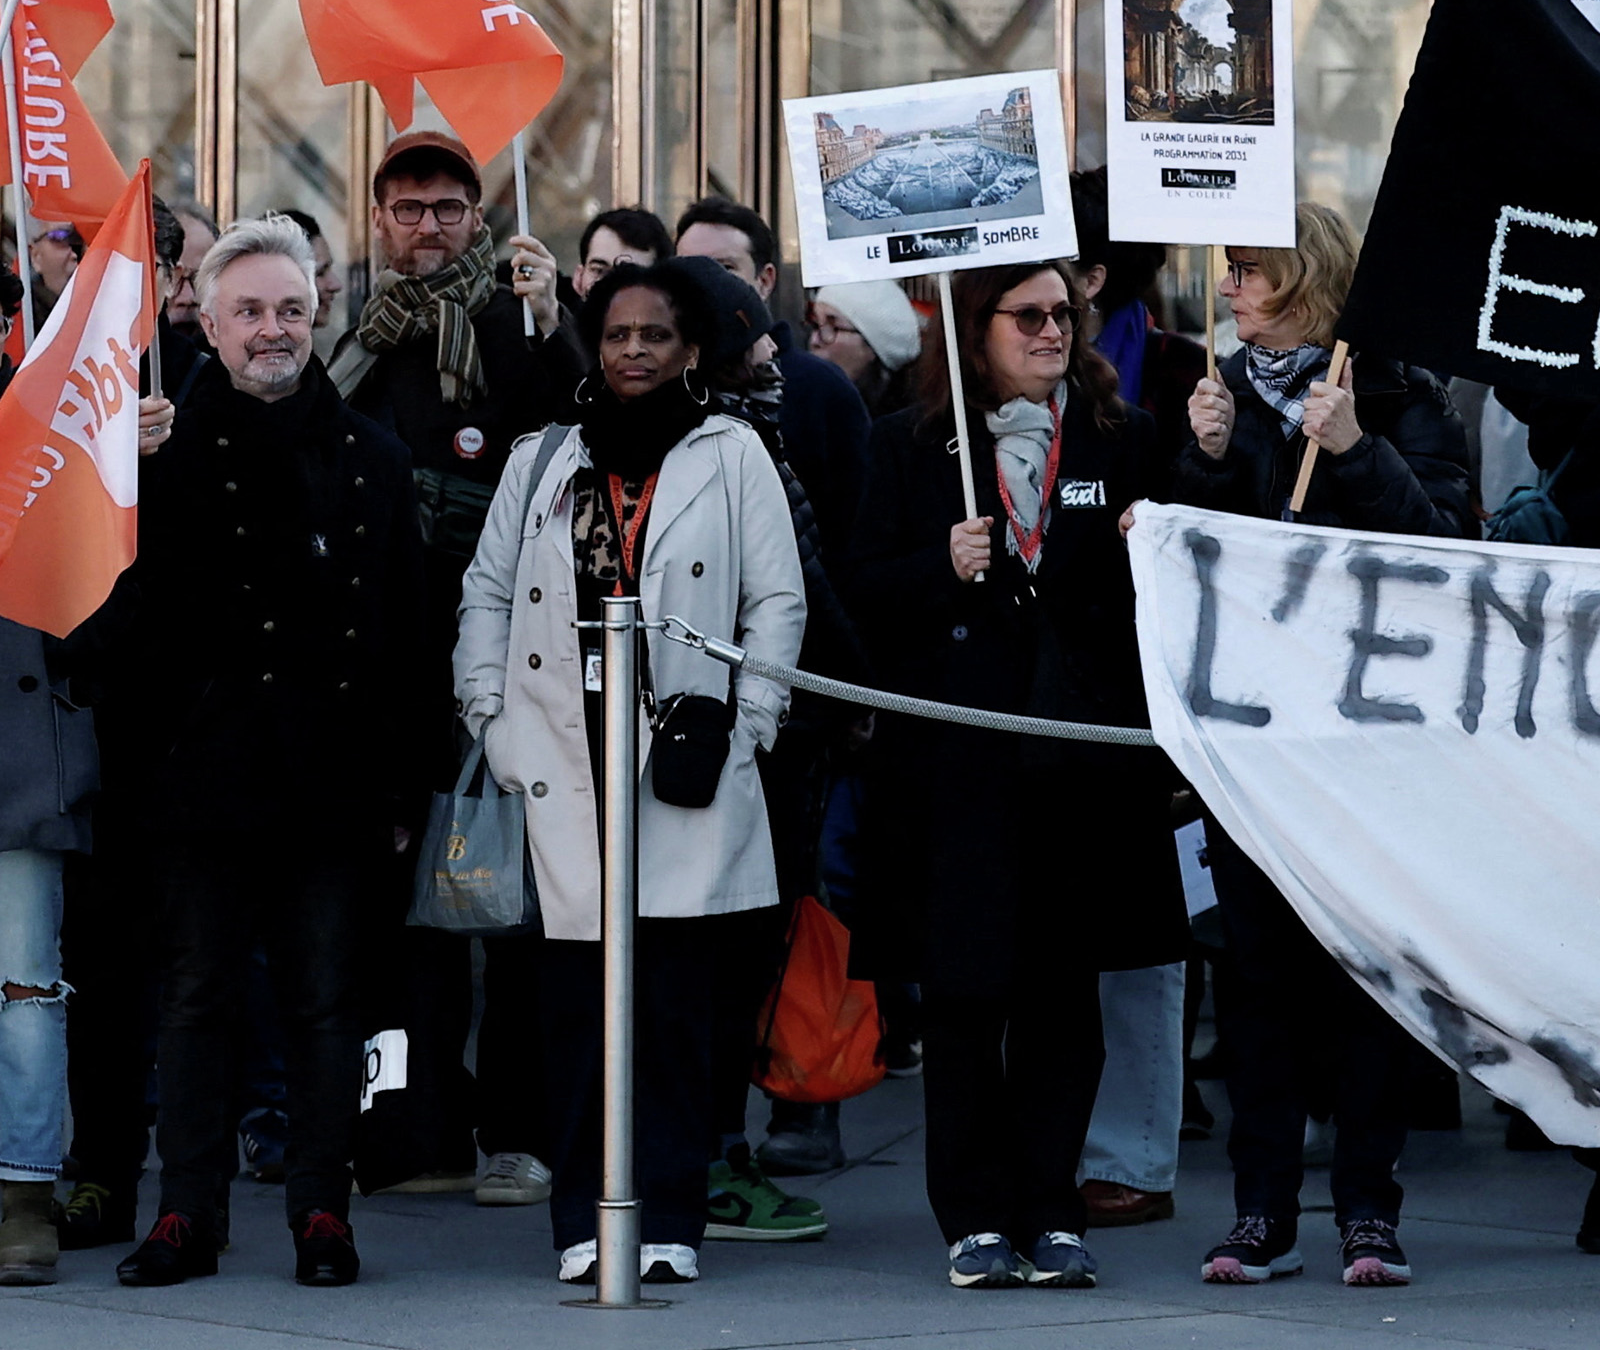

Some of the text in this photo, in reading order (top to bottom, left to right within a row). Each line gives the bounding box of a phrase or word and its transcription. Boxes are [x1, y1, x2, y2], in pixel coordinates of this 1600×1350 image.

[1141, 132, 1151, 142] LA
[1153, 132, 1185, 143] GRANDE
[1187, 132, 1219, 144] GALERIE
[1222, 135, 1232, 144] EN
[1154, 148, 1223, 160] PROGRAMMATION
[1167, 189, 1181, 198] EN
[867, 246, 881, 260] LE
[983, 226, 1040, 246] SOMBRE
[1061, 481, 1097, 506] Sud
